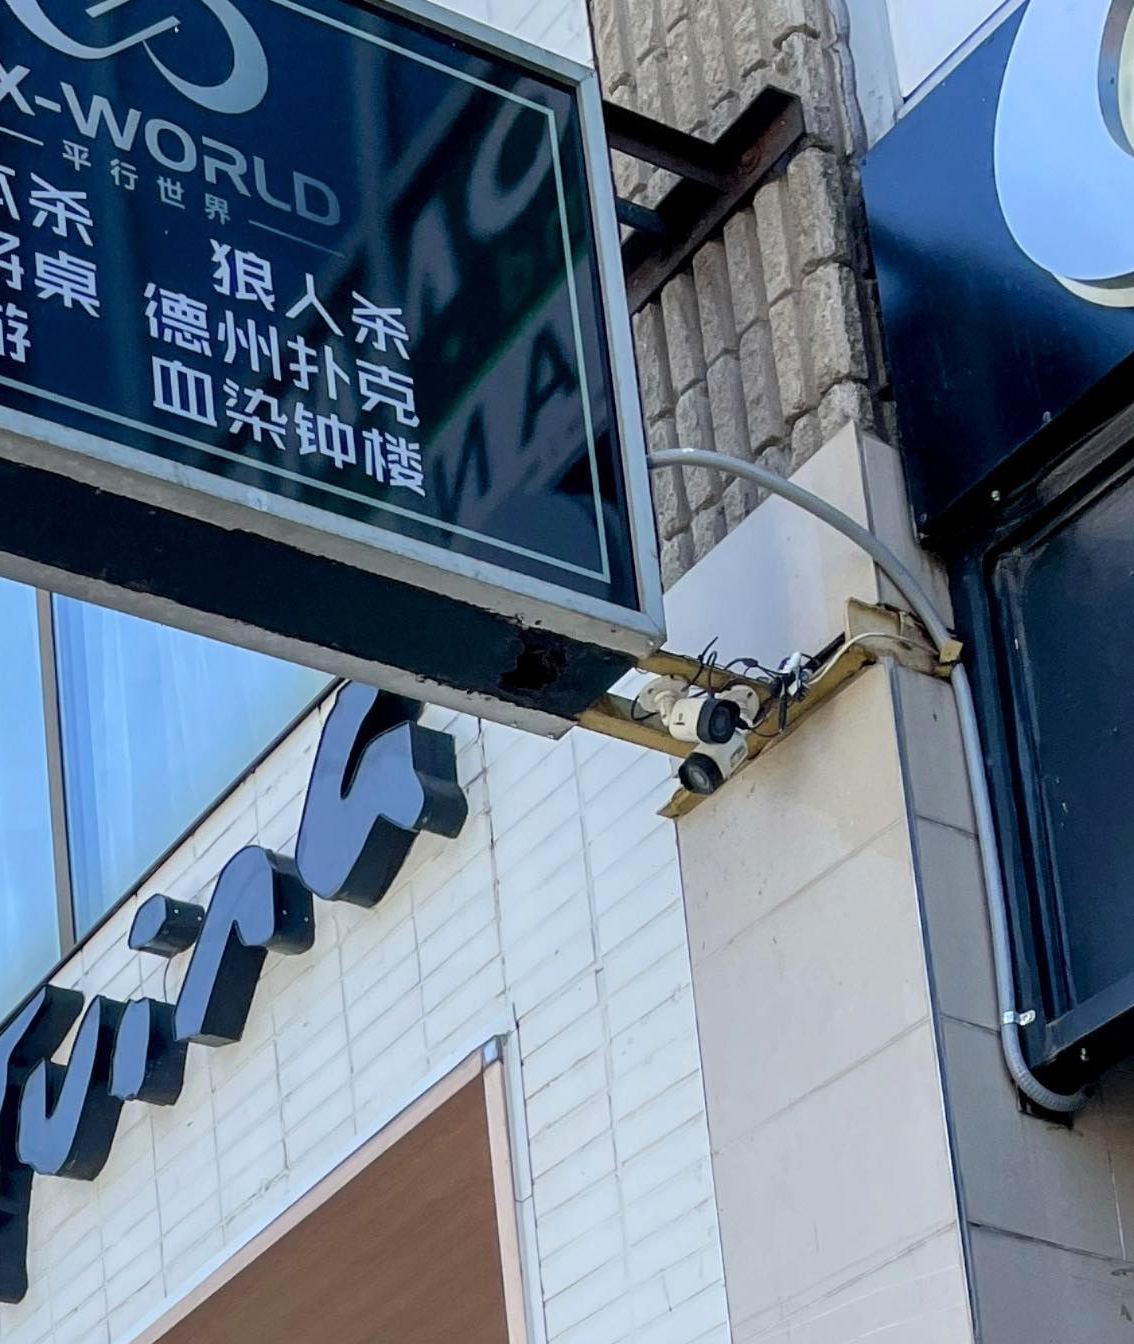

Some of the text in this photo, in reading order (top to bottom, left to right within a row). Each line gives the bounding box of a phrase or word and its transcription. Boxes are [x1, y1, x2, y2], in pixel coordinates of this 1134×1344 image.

[62, 139, 231, 226] 平行世界
[144, 282, 420, 427] 德州扑克
[210, 238, 410, 360] 狼人杀
[151, 355, 425, 497] 血染钟楼
